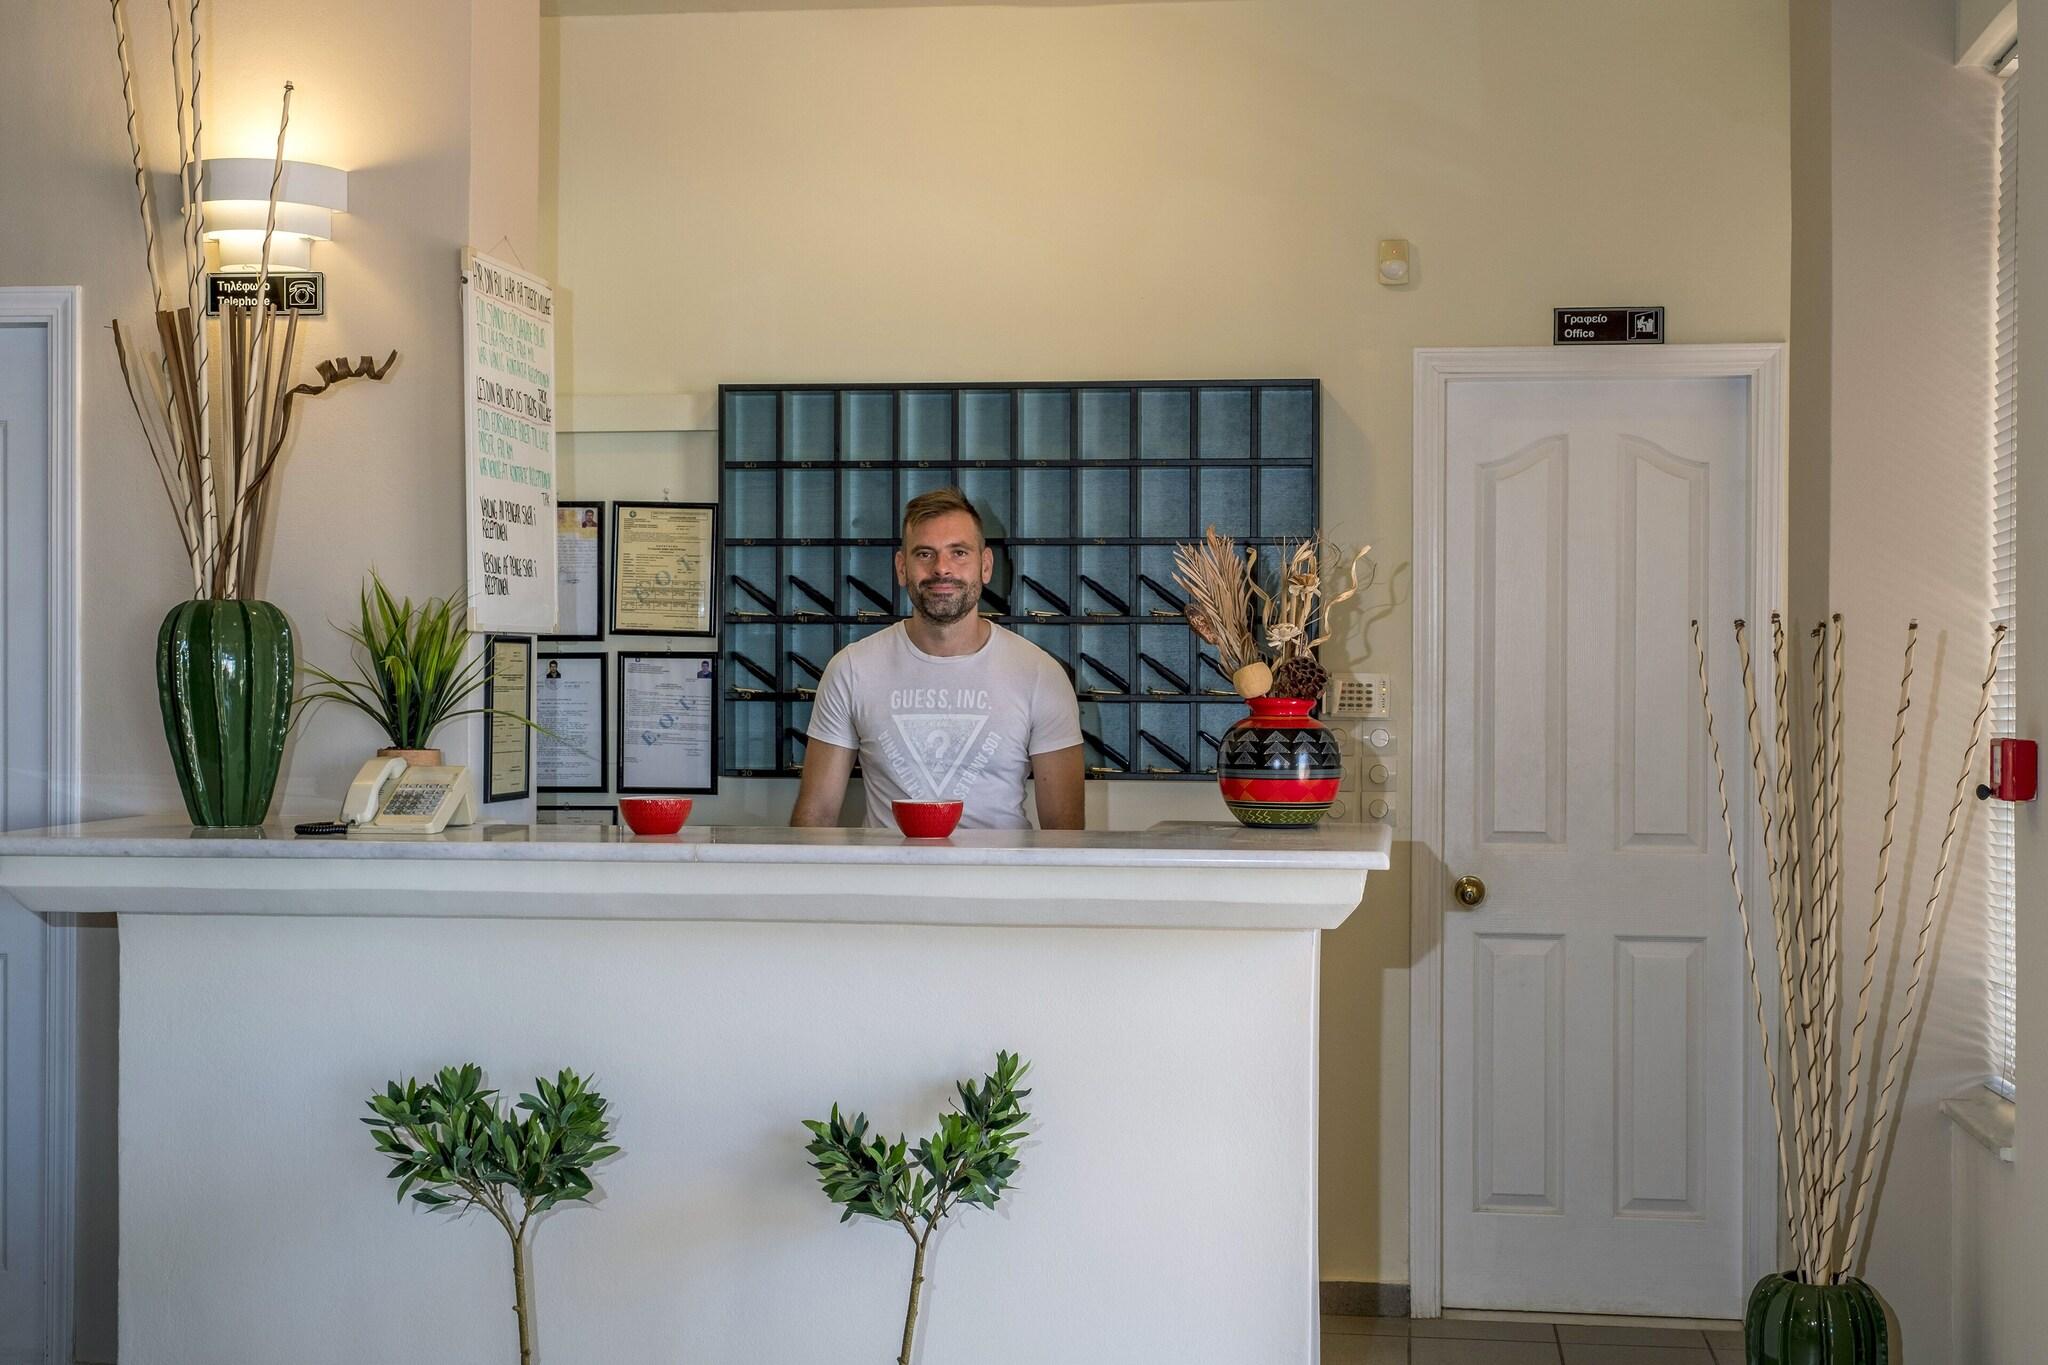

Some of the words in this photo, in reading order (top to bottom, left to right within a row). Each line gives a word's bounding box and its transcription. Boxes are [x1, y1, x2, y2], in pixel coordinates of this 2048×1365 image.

[217, 280, 271, 293] Τηλέφωο
[217, 296, 271, 307] Telephoe
[1564, 313, 1608, 325] Γραφείο
[1564, 328, 1595, 338] Office
[956, 688, 992, 711] INC.
